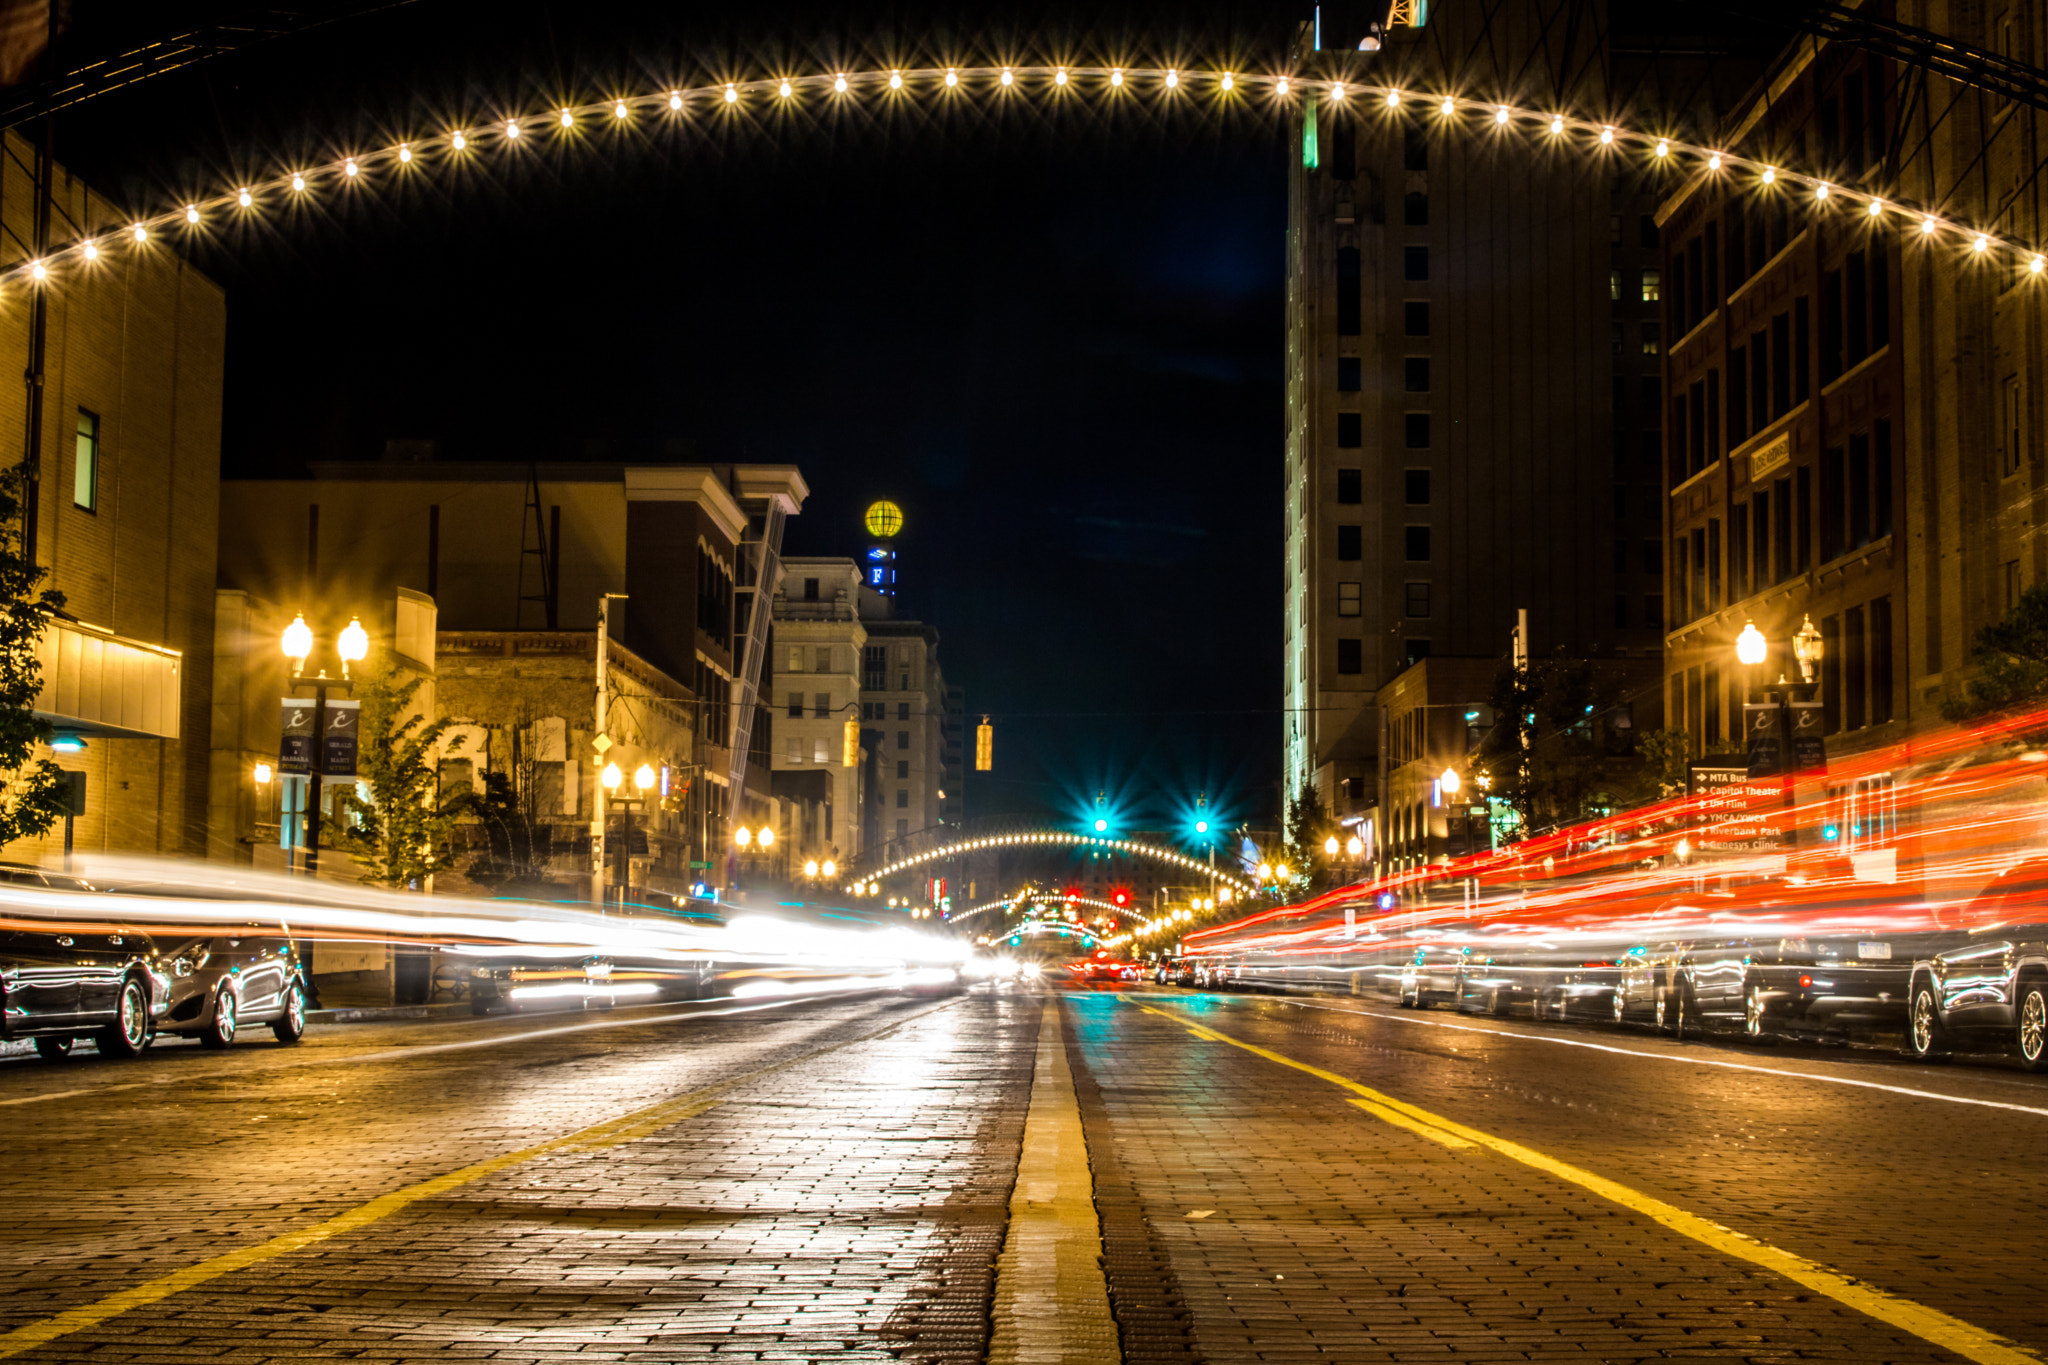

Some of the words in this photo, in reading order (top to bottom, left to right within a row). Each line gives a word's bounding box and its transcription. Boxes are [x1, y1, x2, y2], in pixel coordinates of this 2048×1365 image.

[1710, 774, 1728, 782] MTA
[1730, 774, 1747, 782] Bus
[1710, 786, 1743, 796] Capitol
[1745, 787, 1780, 796] Theater
[1726, 800, 1747, 808] Flint
[1710, 826, 1757, 835] Riverbank
[1760, 827, 1781, 836] Park
[1710, 841, 1749, 851] Genesys
[1752, 841, 1778, 849] Clinic
